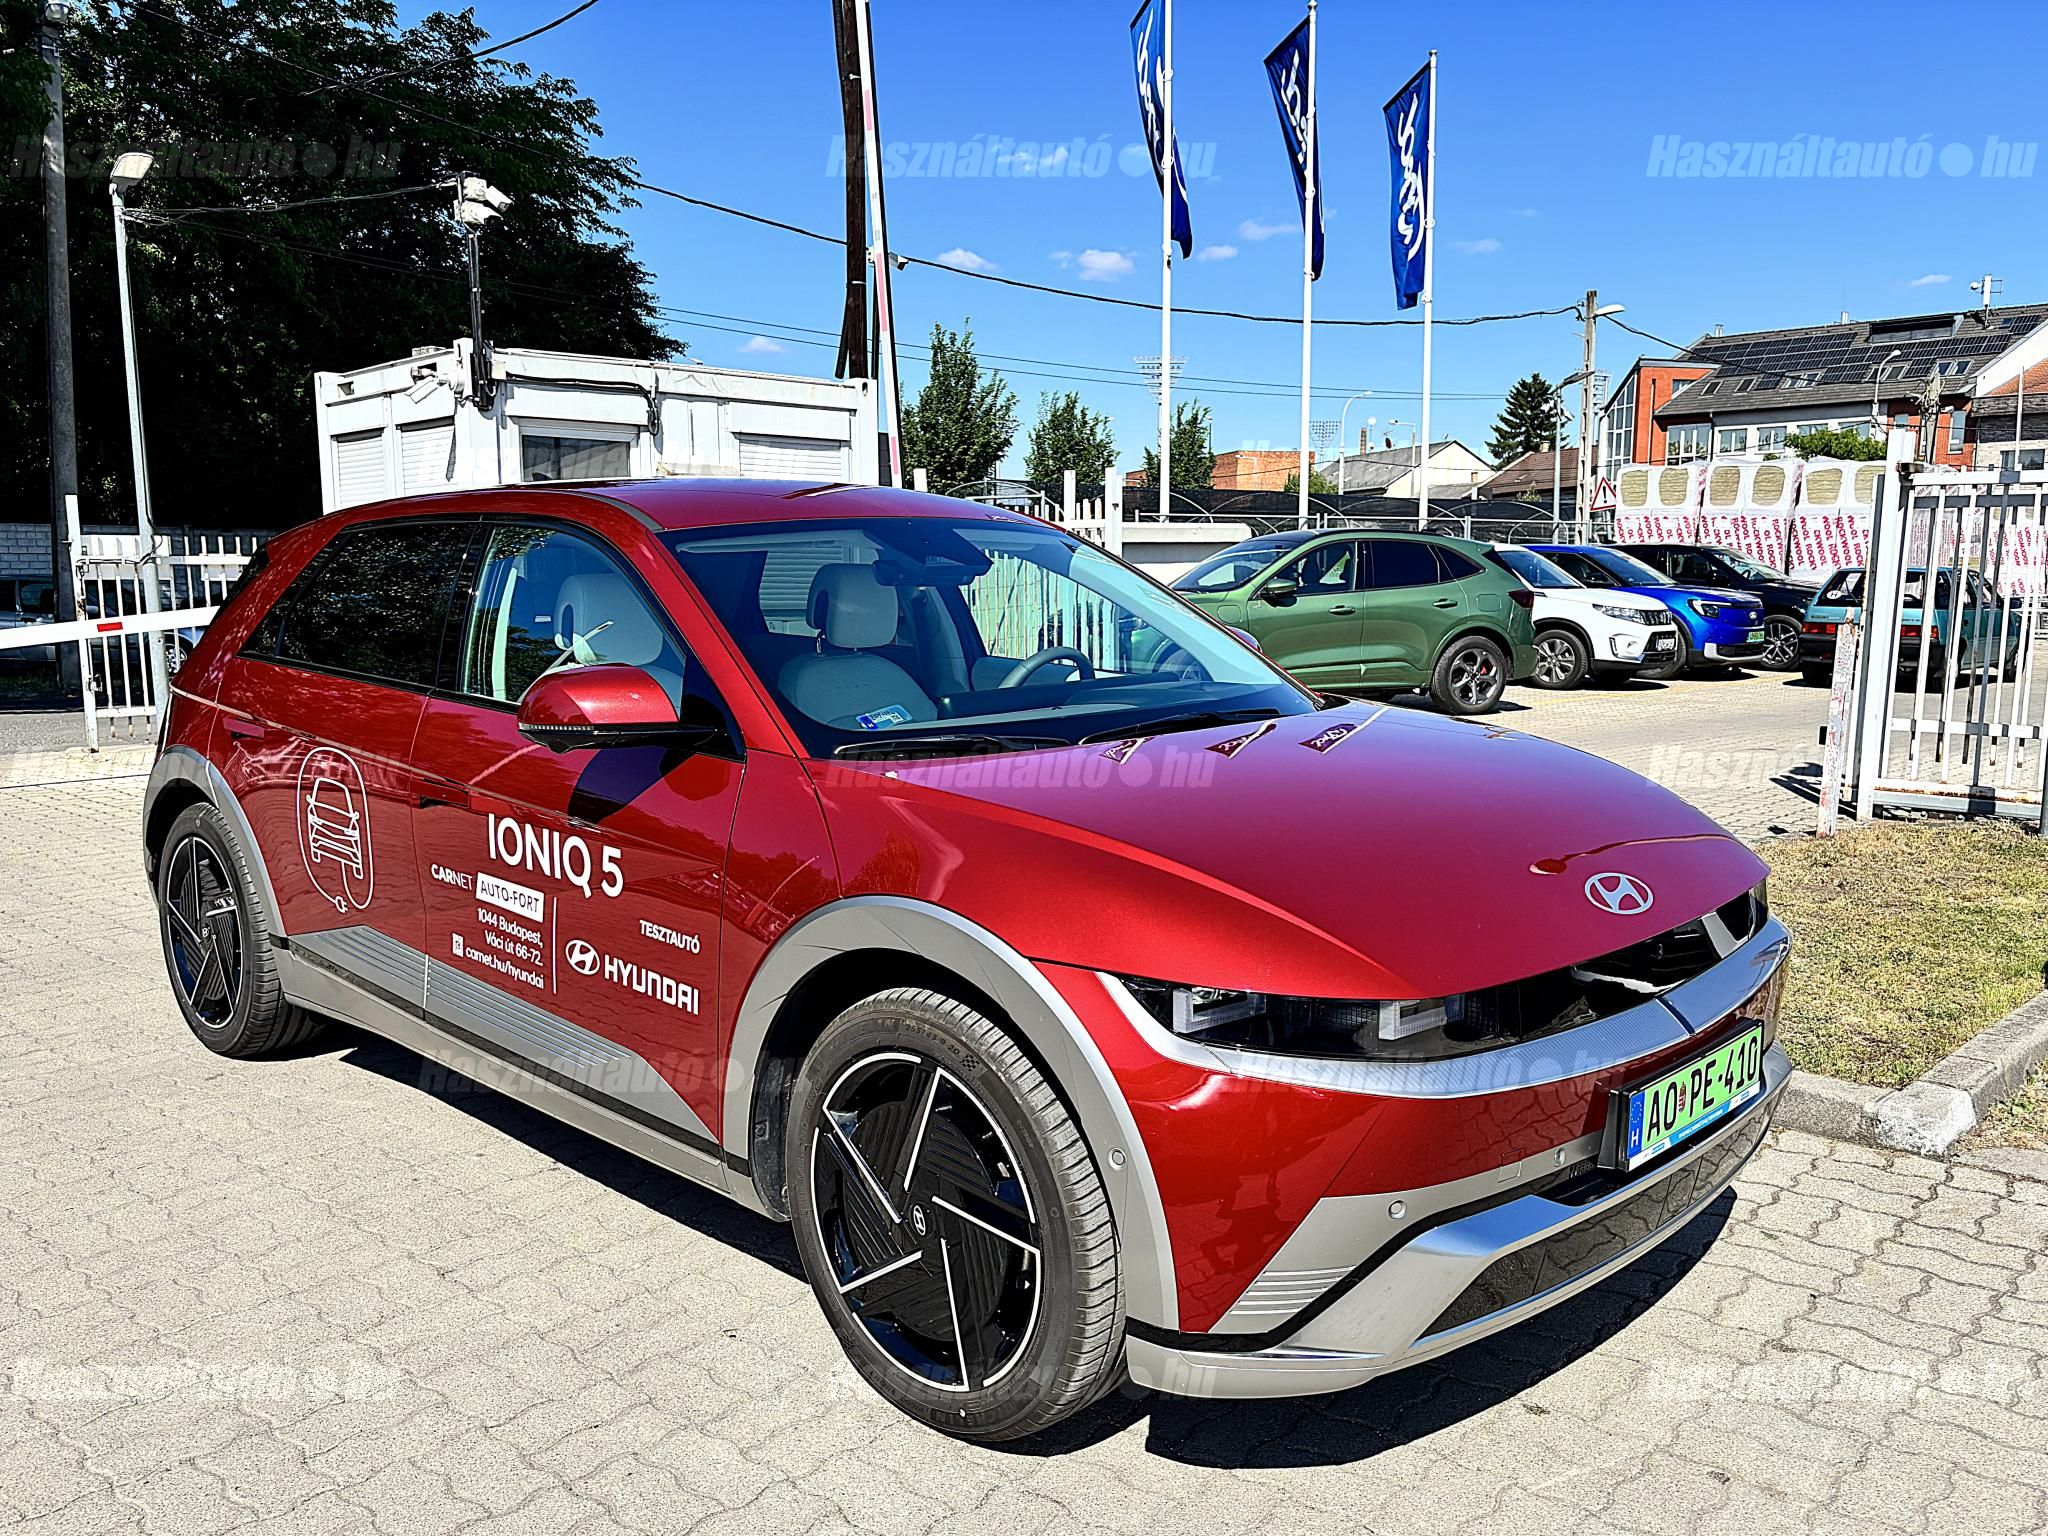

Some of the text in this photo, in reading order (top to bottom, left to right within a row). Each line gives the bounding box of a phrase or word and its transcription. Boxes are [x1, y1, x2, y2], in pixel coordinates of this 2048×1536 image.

[488, 812, 624, 899] IONIQ 5
[431, 863, 540, 913] CARNET AUTO-FORT
[477, 907, 544, 949] 1044 Budapest,
[484, 929, 504, 950] Váci
[505, 938, 515, 955] út
[639, 919, 701, 954] TESZTAUTÓ
[465, 946, 545, 989] carnet.hu/hyundai
[604, 955, 699, 1015] HYUNDAI
[1647, 1081, 1678, 1142] AO
